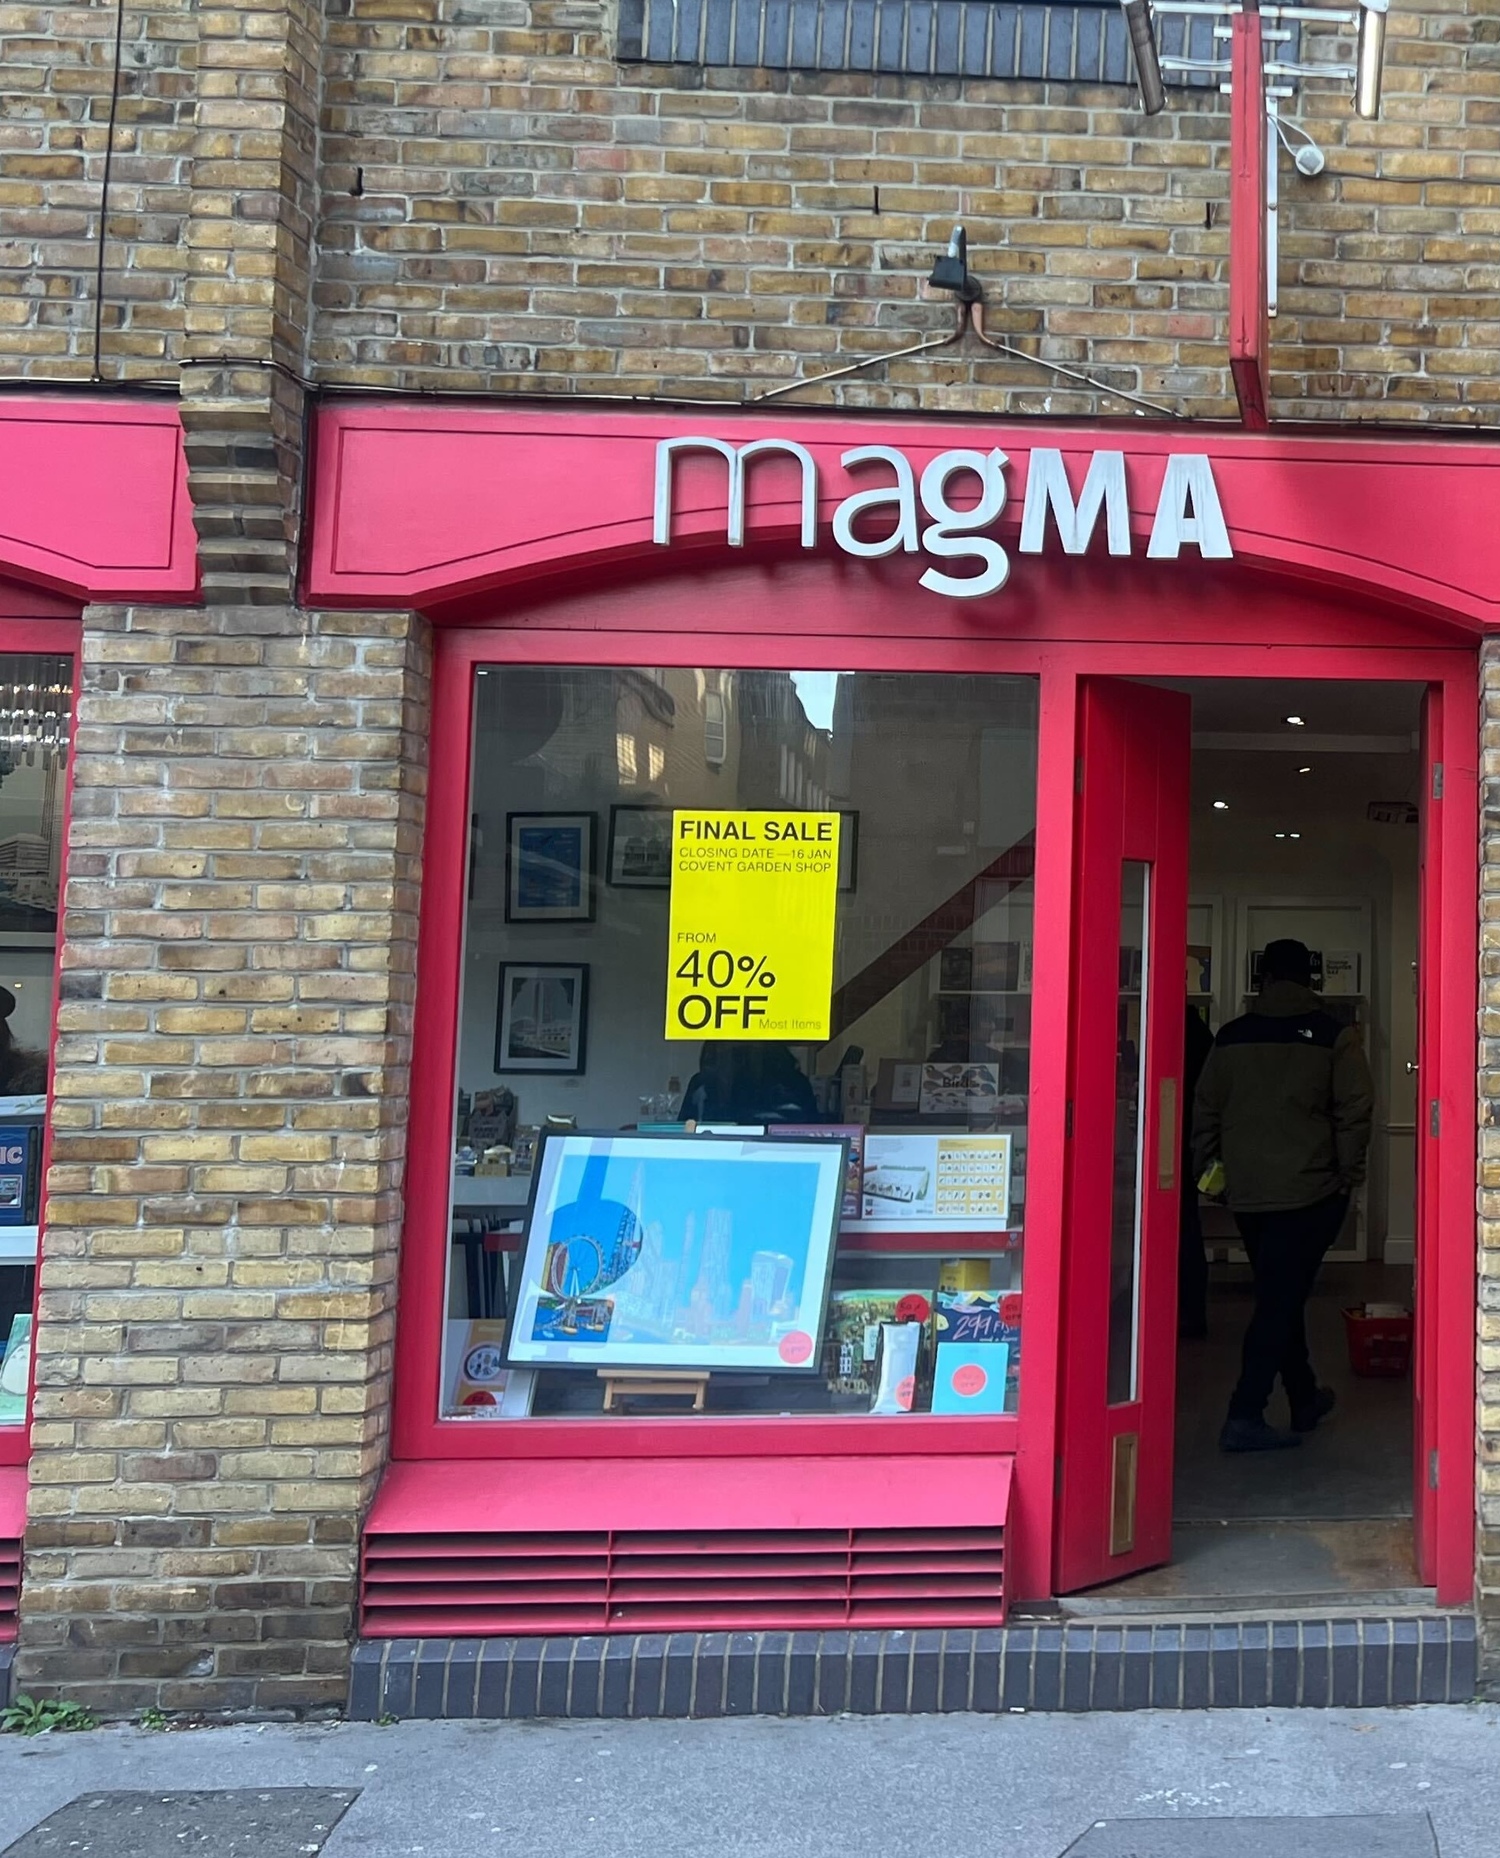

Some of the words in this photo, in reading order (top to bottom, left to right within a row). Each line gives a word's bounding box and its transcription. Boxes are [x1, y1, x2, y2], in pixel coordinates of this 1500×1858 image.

[653, 436, 1233, 599] magMA
[680, 820, 756, 840] FINAL
[764, 821, 833, 841] SALE
[679, 847, 738, 858] CLOSING
[742, 848, 774, 859] DATE
[808, 849, 832, 860] JAN
[679, 861, 734, 872] COVENT
[737, 862, 792, 873] GARDEN
[795, 862, 831, 873] SHOP
[676, 932, 717, 944] FROM
[676, 949, 776, 989] 40%
[677, 994, 769, 1030] OFF
[758, 1018, 788, 1030] Most
[791, 1019, 822, 1030] Items
[953, 1314, 992, 1340] 299
